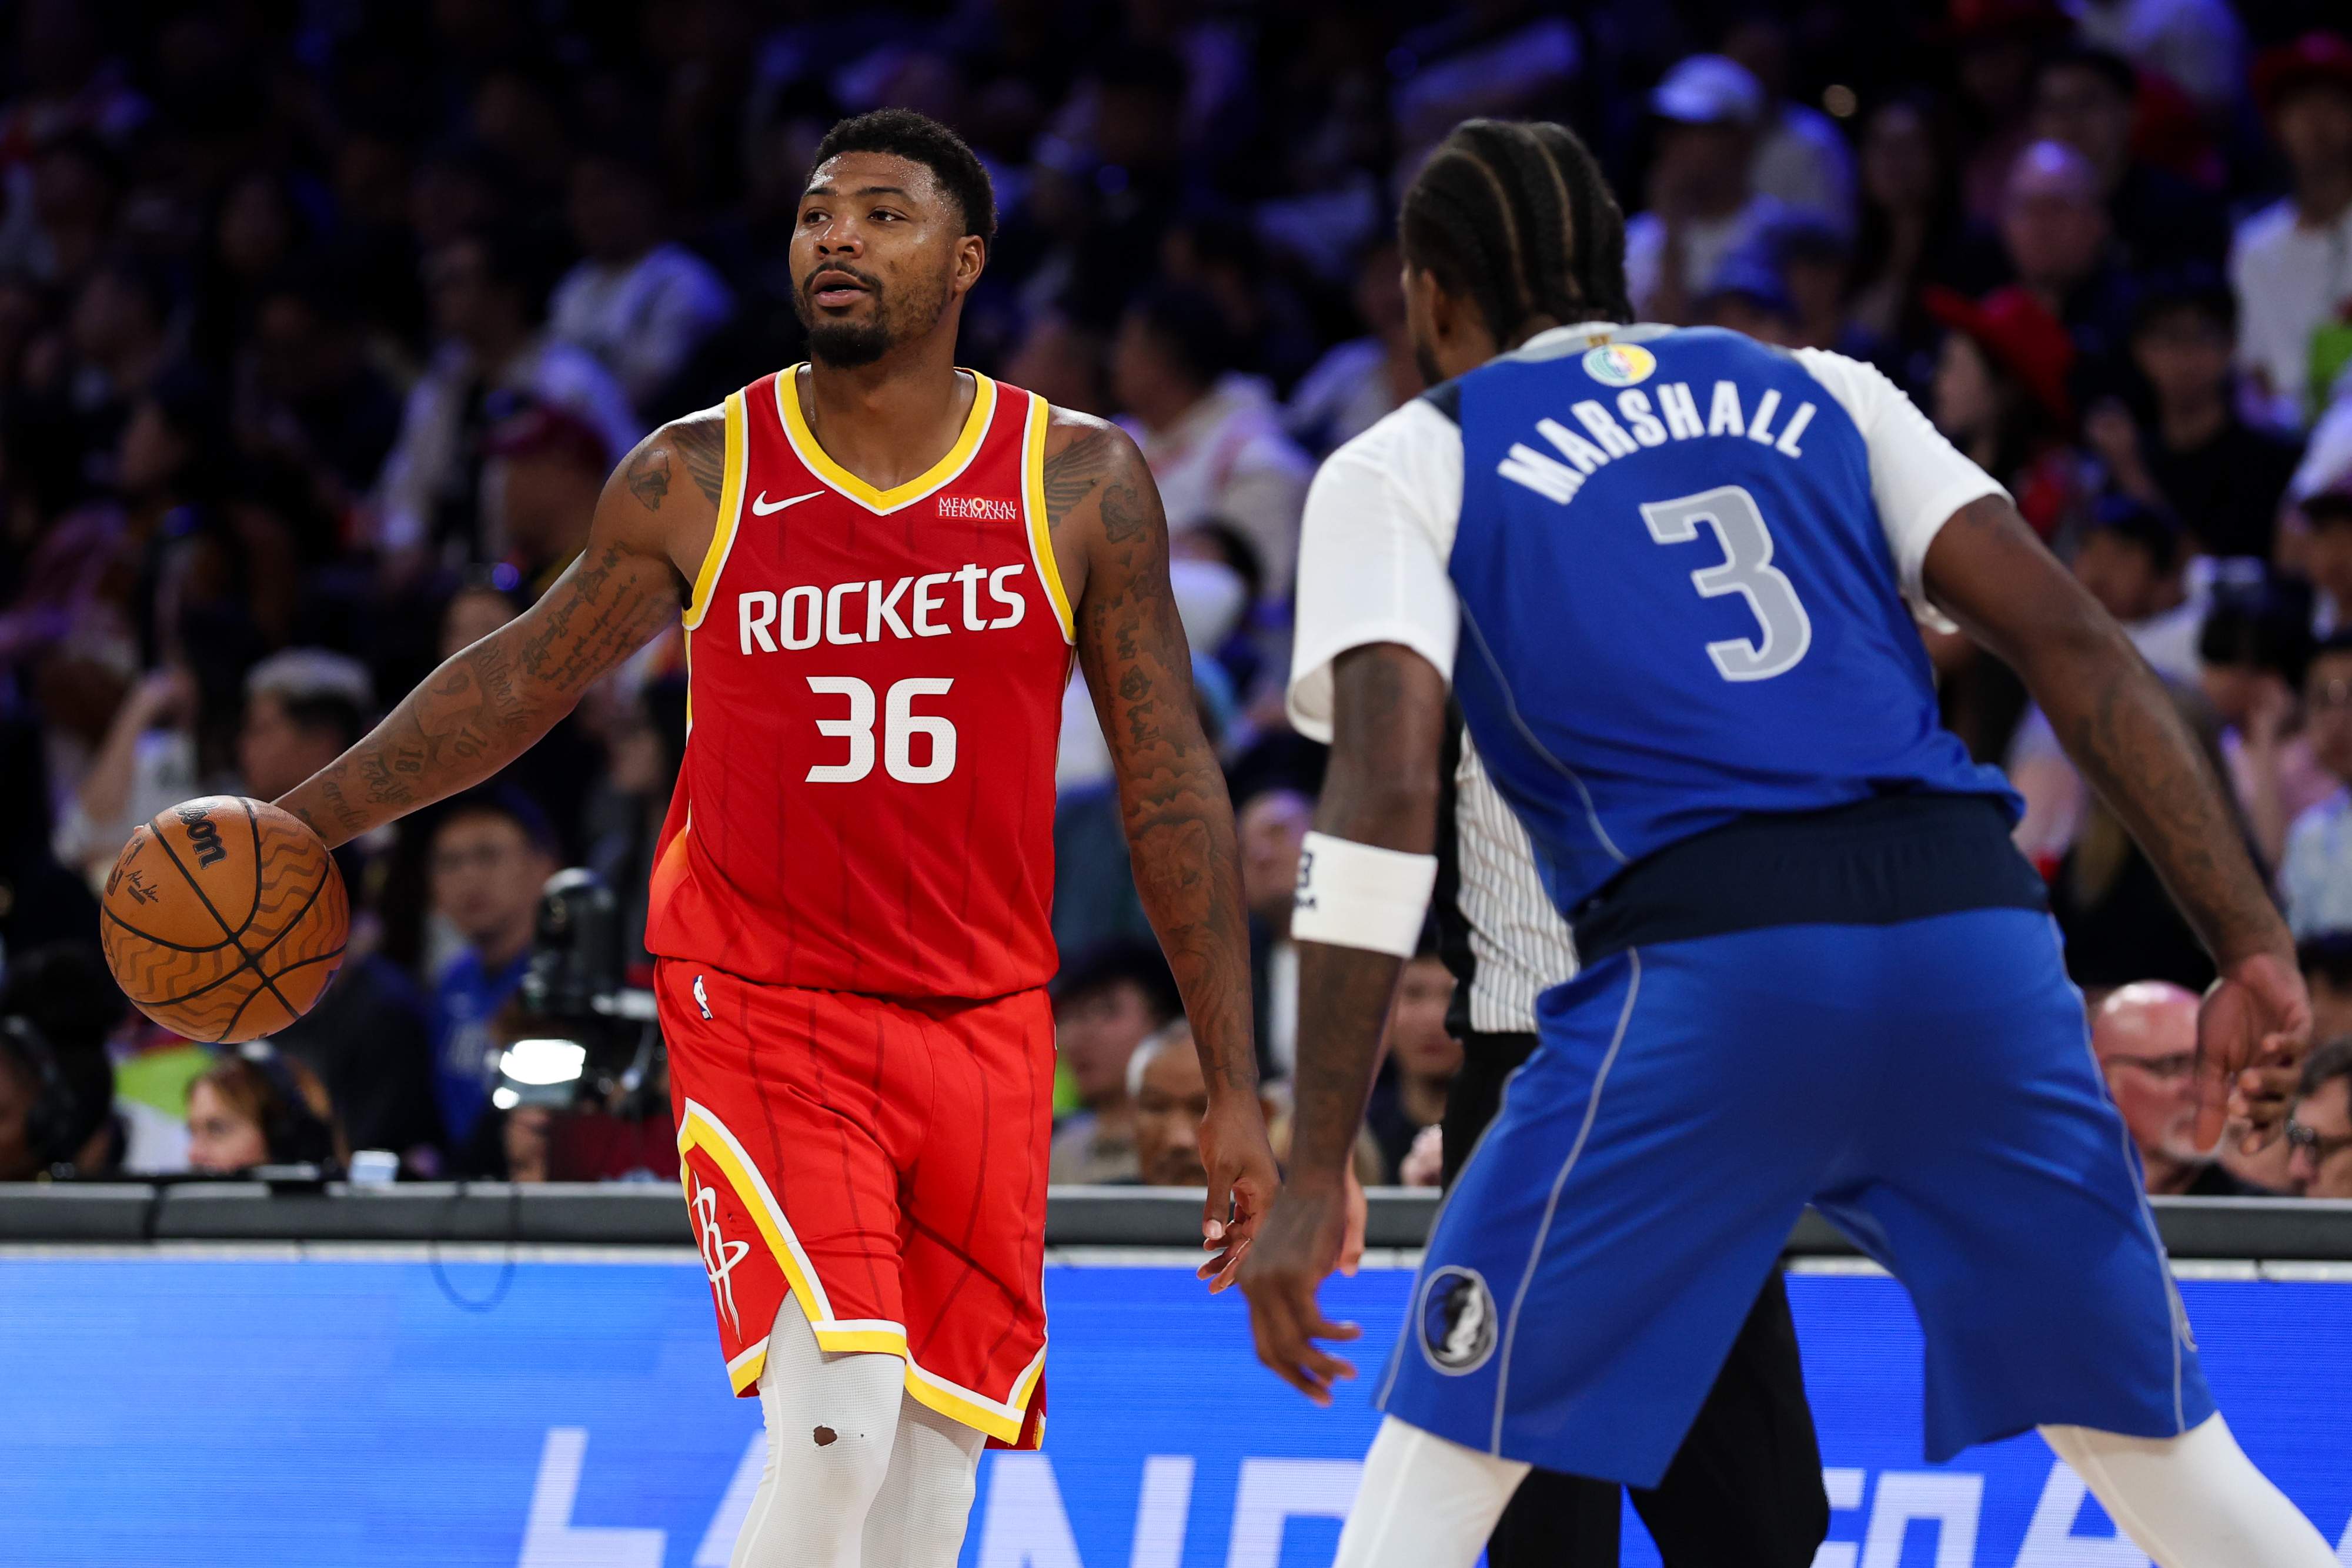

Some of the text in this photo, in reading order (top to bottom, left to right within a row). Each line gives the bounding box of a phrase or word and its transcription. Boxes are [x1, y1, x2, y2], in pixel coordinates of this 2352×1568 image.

[1497, 380, 1817, 506] MARSHALL
[938, 497, 1016, 511] MEMORIAL
[939, 506, 1016, 520] HERMANN
[739, 563, 1025, 655] ROCKETS
[1639, 486, 1812, 682] 3
[805, 676, 957, 783] 36
